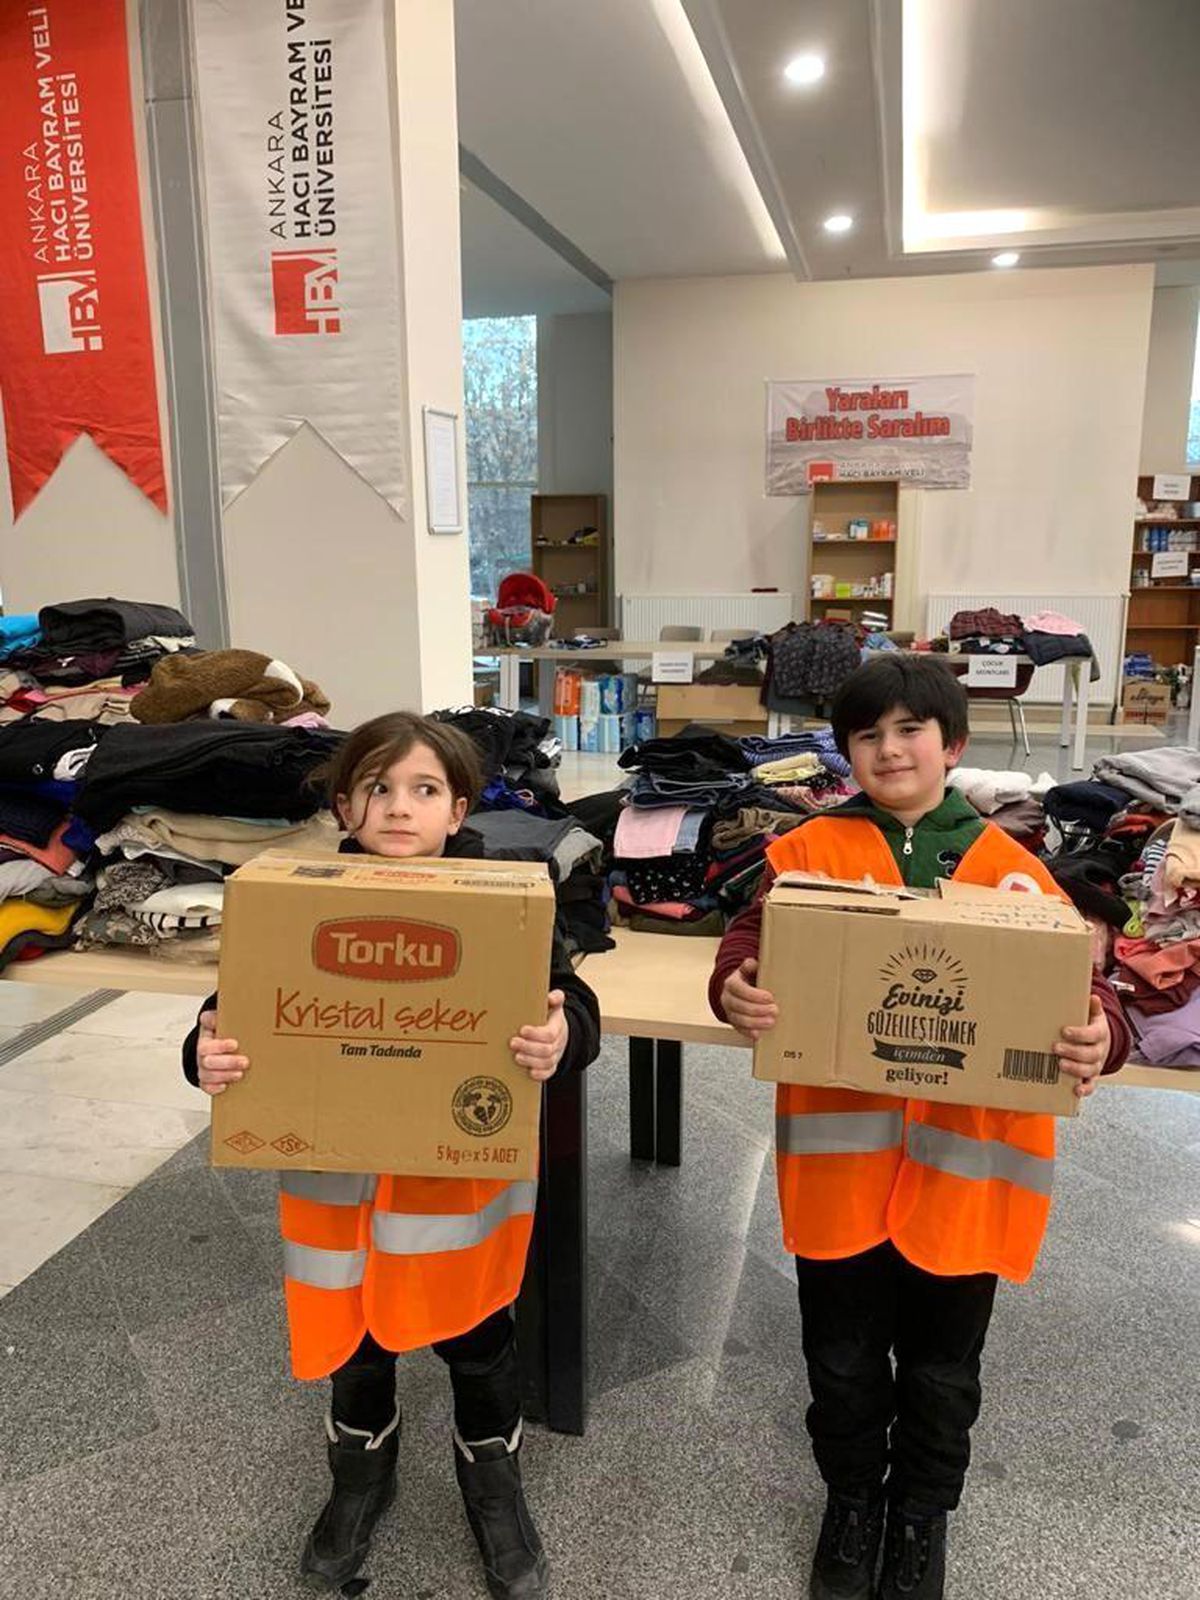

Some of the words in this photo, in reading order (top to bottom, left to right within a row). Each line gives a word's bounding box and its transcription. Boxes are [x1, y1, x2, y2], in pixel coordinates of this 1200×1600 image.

[28, 8, 51, 69] VELİ
[287, 41, 309, 162] BAYRAM
[38, 77, 64, 190] BAYRAM
[309, 40, 336, 237] ÜNİVERSİTESİ
[55, 73, 94, 260] ÜNİVERSİTESİ
[267, 110, 288, 239] ANKARA
[22, 142, 50, 263] ANKARA
[50, 199, 72, 261] HACI
[292, 172, 311, 237] HACI
[786, 415, 863, 441] Birlikte
[868, 411, 951, 438] Saralım
[330, 931, 443, 968] Torku
[275, 987, 385, 1031] Kristal
[394, 998, 489, 1035] şeker
[882, 983, 965, 1016] Evinizi
[340, 1043, 367, 1057] Tam
[370, 1044, 422, 1059] Tadında
[885, 1067, 949, 1086] geliyor!
[491, 1147, 519, 1163] ADET
